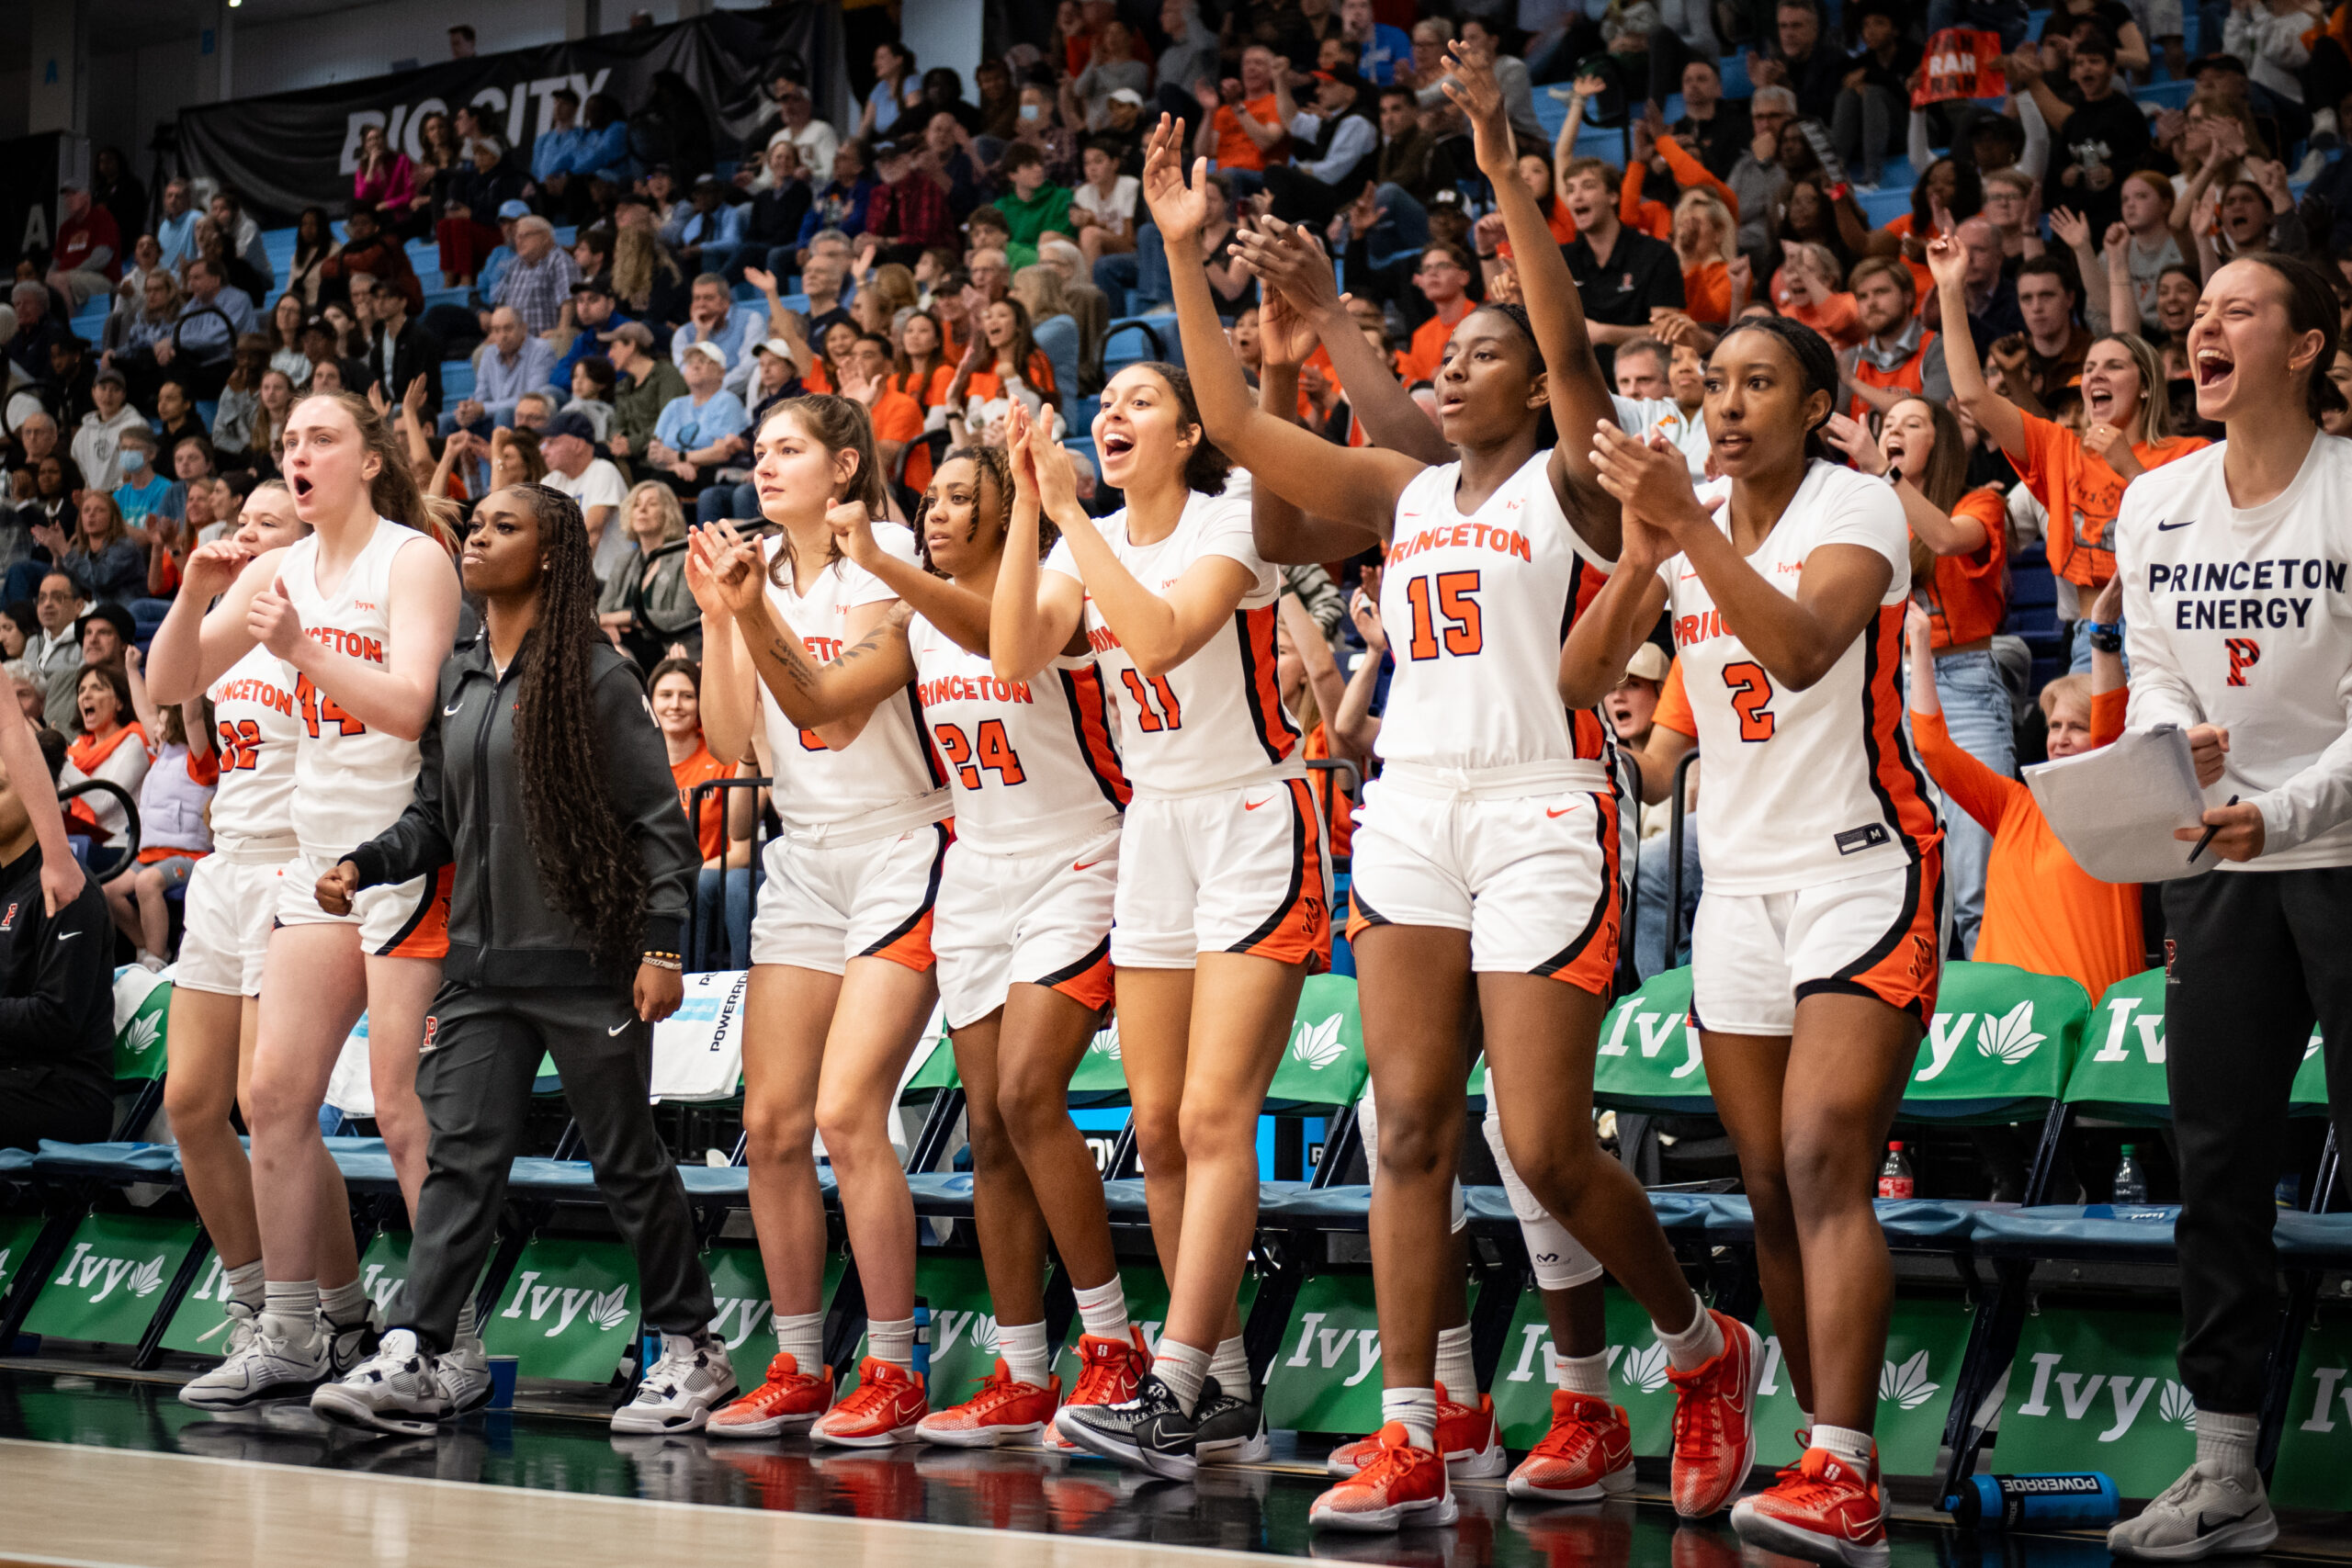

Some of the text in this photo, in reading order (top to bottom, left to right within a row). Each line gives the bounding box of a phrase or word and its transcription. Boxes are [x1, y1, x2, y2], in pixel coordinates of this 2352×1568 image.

[1928, 51, 1976, 77] RAH
[21, 202, 49, 253] A
[1385, 523, 1532, 570] RINCETON
[2149, 558, 2347, 593] PRINCETON
[355, 600, 369, 612] Ivy
[1407, 570, 1483, 661] 15
[2176, 597, 2313, 630] ENERGY
[305, 627, 383, 664] CETON
[2224, 638, 2261, 687] P
[917, 675, 1034, 711] RINCETON
[1121, 668, 1182, 733] 11
[1722, 660, 1775, 742] 2
[219, 719, 265, 773] 32
[934, 718, 1027, 791] 24
[1870, 829, 1882, 840] M
[424, 1016, 437, 1046] P
[2093, 998, 2166, 1064] Iv
[54, 1242, 135, 1303] Ivy
[501, 1270, 594, 1337] Ivy
[709, 1282, 772, 1350] vy
[1285, 1313, 1382, 1387] Ivy
[2018, 1352, 2156, 1443] Ivy
[2002, 1476, 2099, 1493] POWERADE
